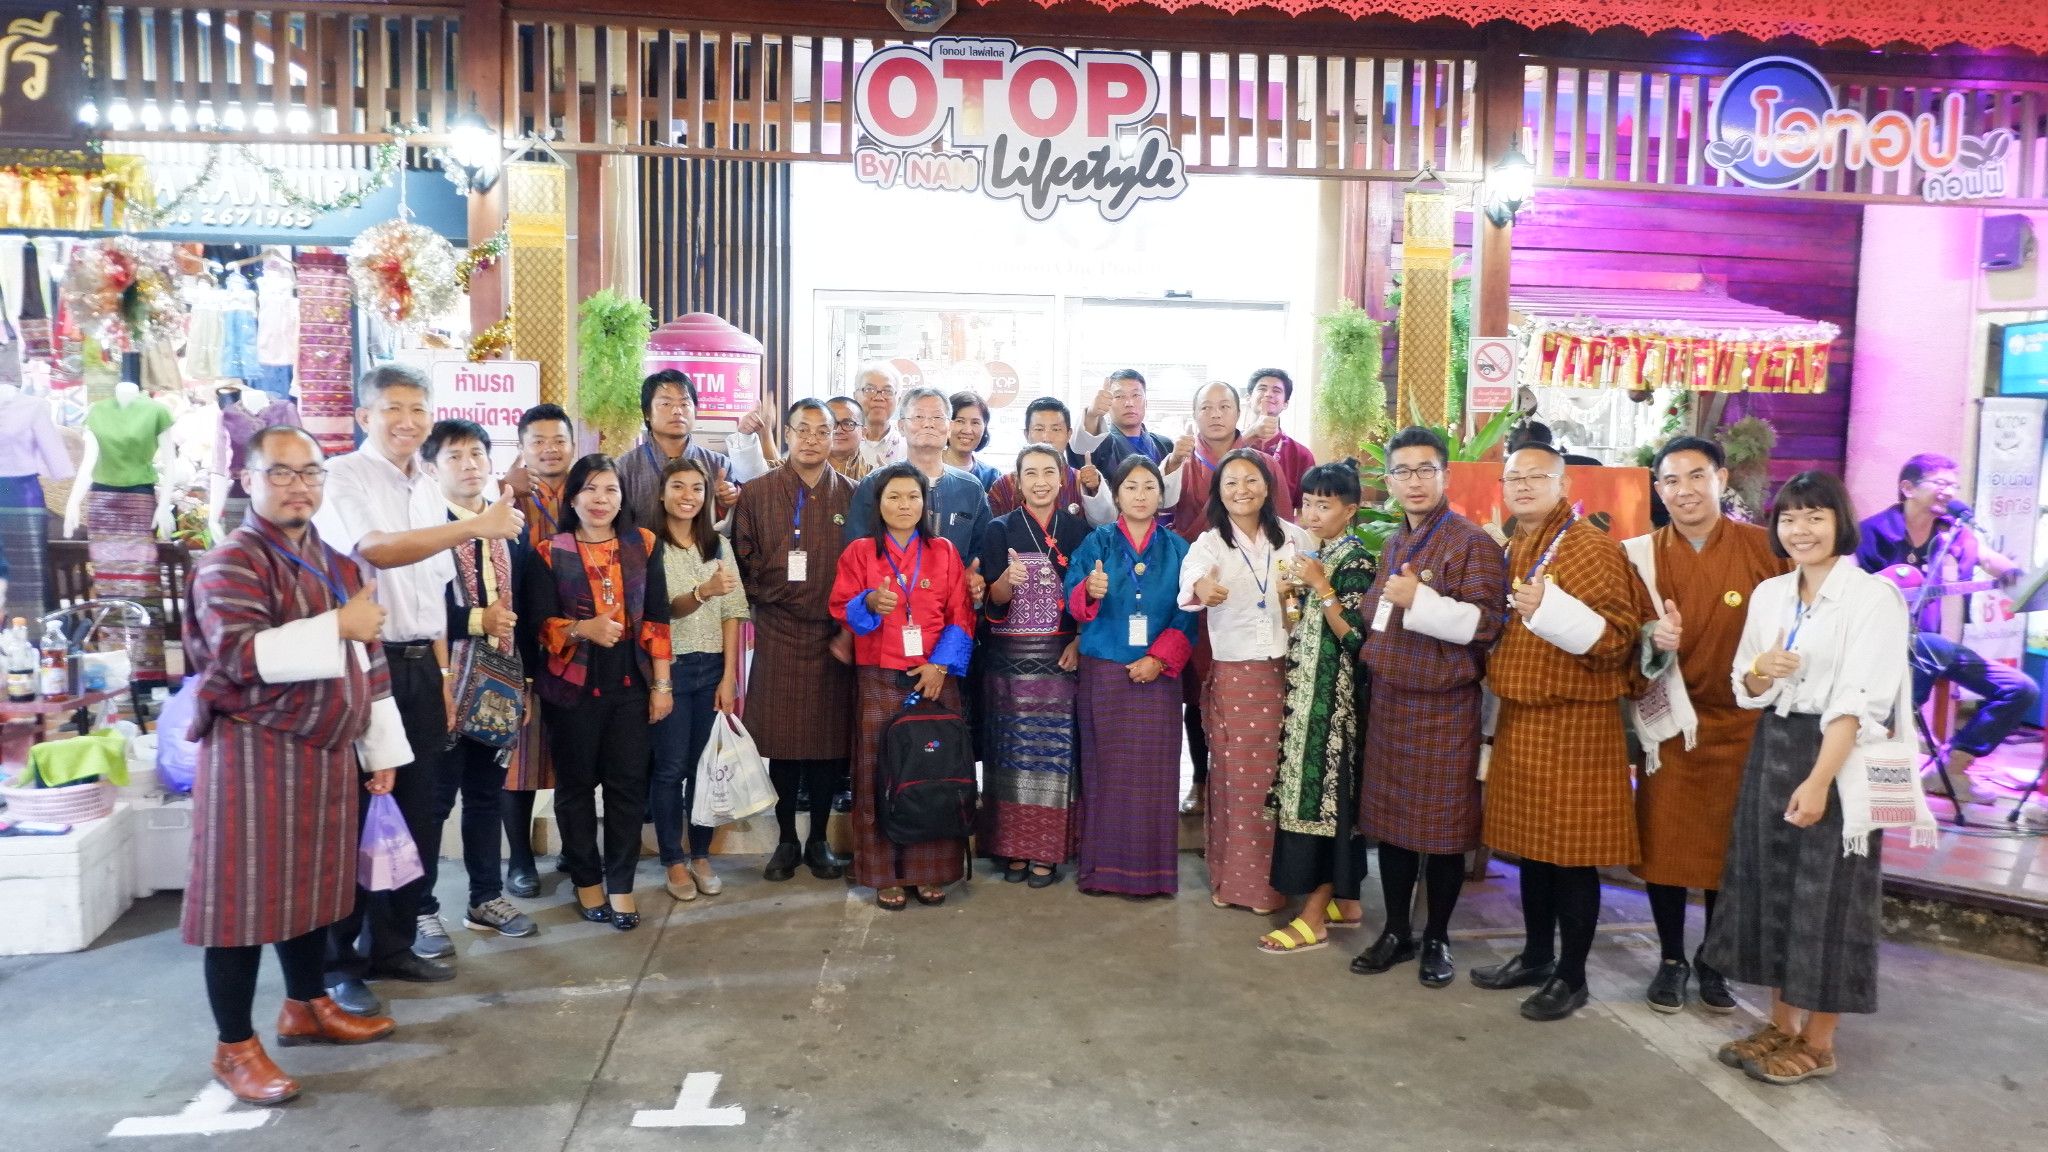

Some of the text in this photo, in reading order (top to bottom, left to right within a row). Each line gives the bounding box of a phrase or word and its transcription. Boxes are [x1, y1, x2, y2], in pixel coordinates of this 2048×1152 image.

[0, 10, 63, 101] รี
[939, 44, 966, 57] โอทอป
[867, 56, 1147, 138] OTOP
[1753, 87, 1962, 169] โอทอป
[911, 160, 976, 187] NAN
[991, 133, 1177, 210] Lifestyle
[455, 366, 515, 393] ห้ามรถ
[686, 371, 725, 393] TM
[1540, 333, 1830, 389] HAPPY NEW YEAR
